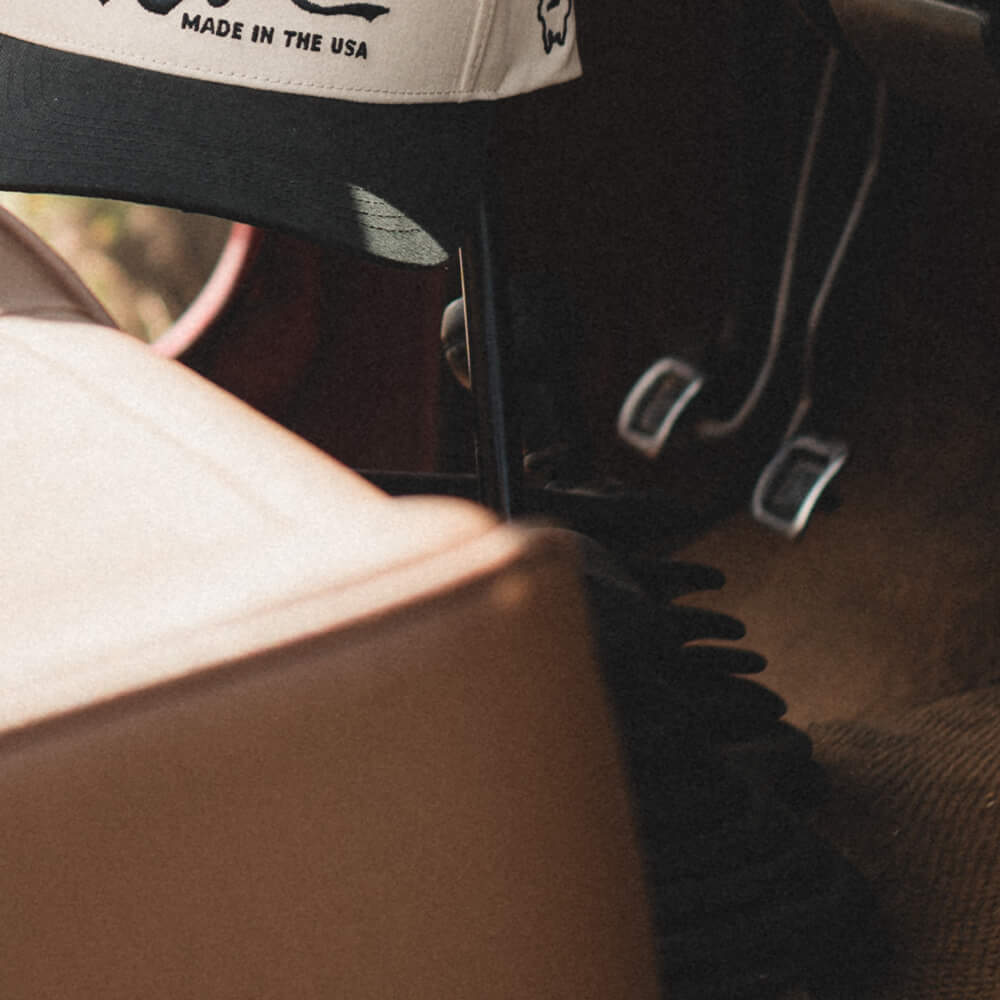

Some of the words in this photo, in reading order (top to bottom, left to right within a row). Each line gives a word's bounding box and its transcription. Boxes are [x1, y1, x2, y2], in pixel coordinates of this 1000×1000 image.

[181, 13, 244, 40] MADE
[251, 24, 274, 44] IN
[283, 30, 323, 52] THE
[330, 37, 368, 59] USA
